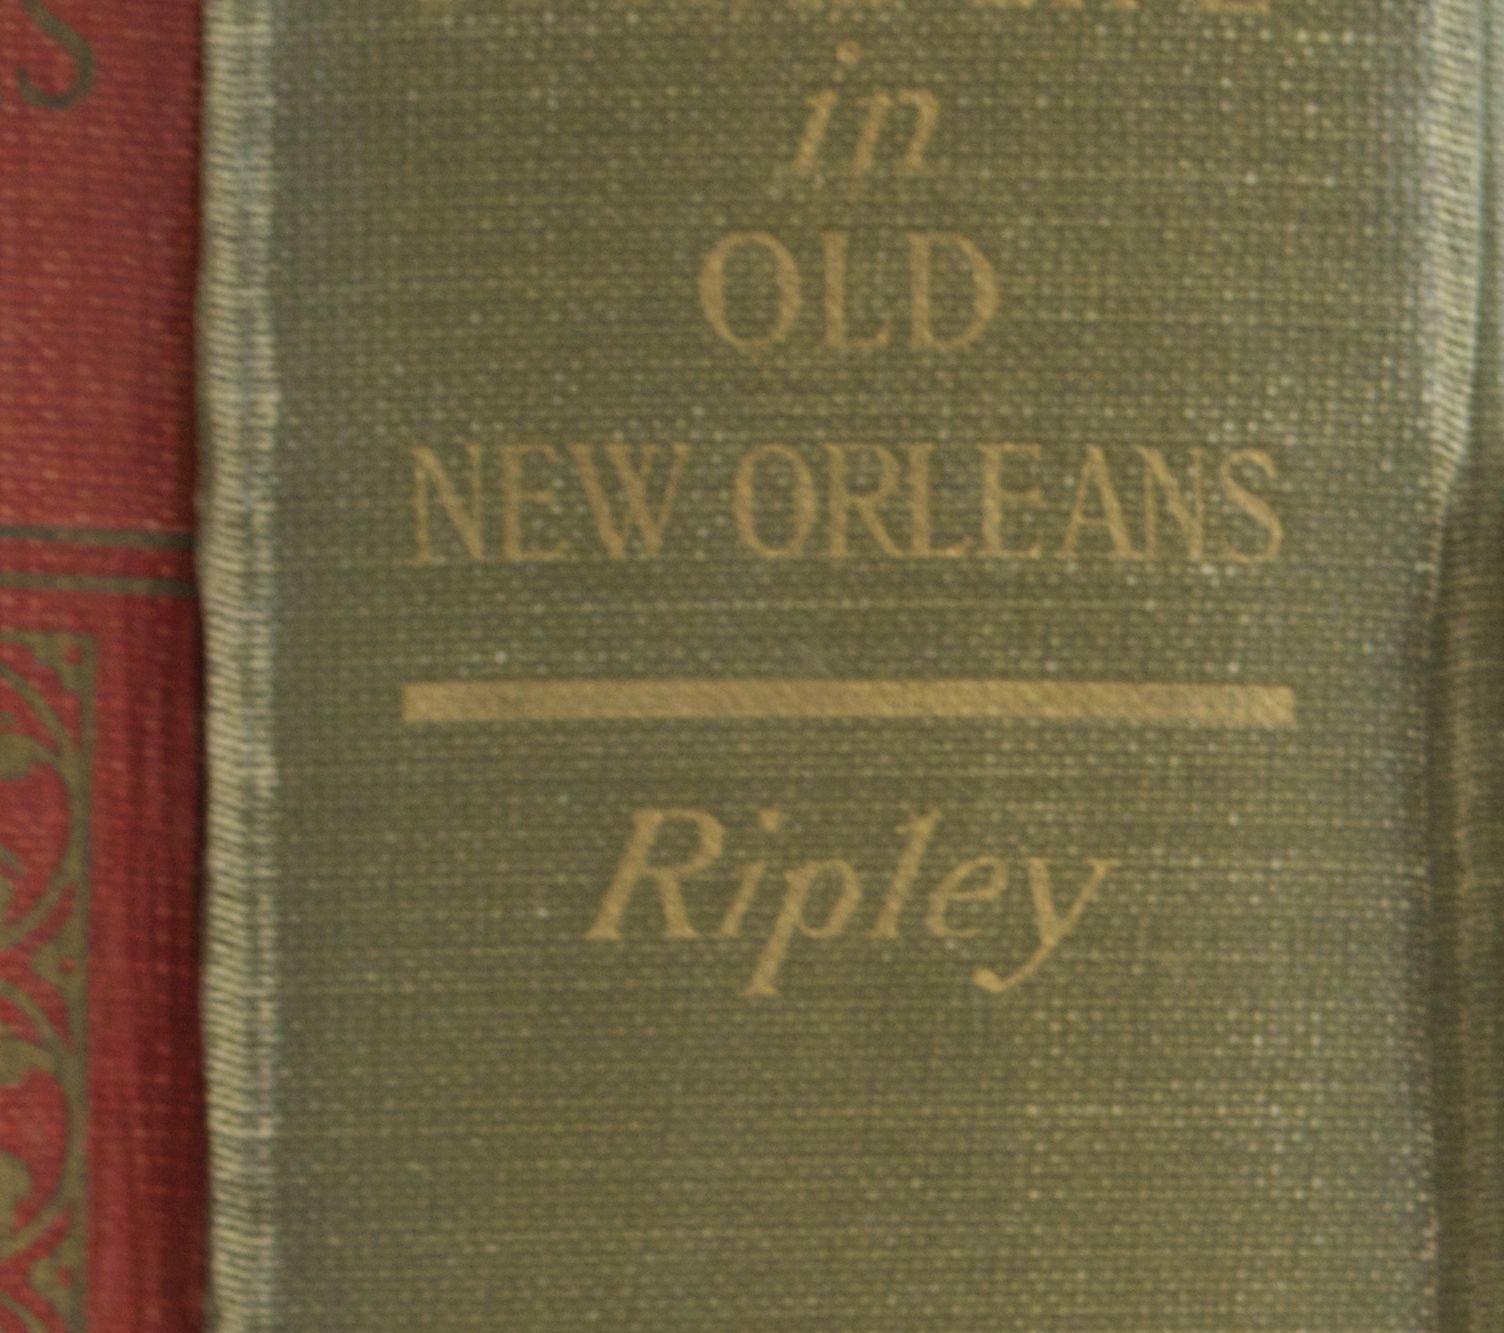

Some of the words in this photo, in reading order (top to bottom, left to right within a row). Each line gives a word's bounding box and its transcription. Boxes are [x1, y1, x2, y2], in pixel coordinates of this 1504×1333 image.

[790, 42, 940, 195] in
[698, 230, 1002, 353] OLD
[409, 440, 691, 563] NEW
[732, 438, 1282, 564] ORLEANS
[586, 806, 1119, 996] Ripley
